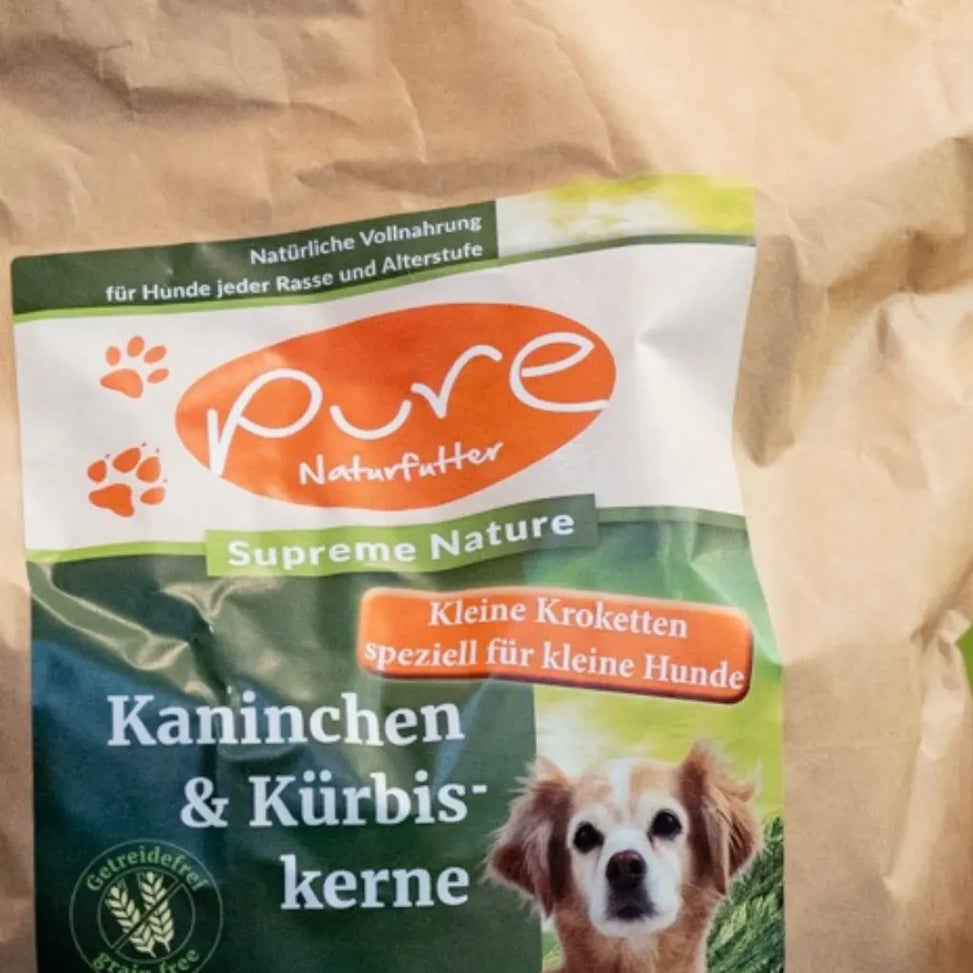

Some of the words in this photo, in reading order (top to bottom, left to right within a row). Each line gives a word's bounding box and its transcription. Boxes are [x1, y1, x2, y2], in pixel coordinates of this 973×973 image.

[249, 235, 355, 265] Natürliche
[359, 215, 482, 246] Vollnahrung
[105, 283, 135, 303] für
[142, 279, 211, 300] Hunde
[215, 275, 270, 300] jeder
[275, 269, 334, 293] Rasse
[338, 264, 377, 286] und
[382, 246, 484, 275] Alterstufe
[300, 441, 503, 486] Naturfutter
[227, 537, 416, 571] Supreme
[430, 511, 576, 559] Nature
[428, 599, 527, 628] Kleine
[536, 598, 689, 638] Kroketten
[363, 639, 478, 668] speziell
[484, 639, 536, 668] für
[541, 641, 634, 680] kleine
[643, 654, 746, 691] Hunde
[107, 690, 465, 748] Kaninchen
[180, 775, 229, 829] &
[249, 770, 487, 827] Kürbis-
[86, 846, 209, 892] Getreidefrei
[280, 854, 470, 911] kerne
